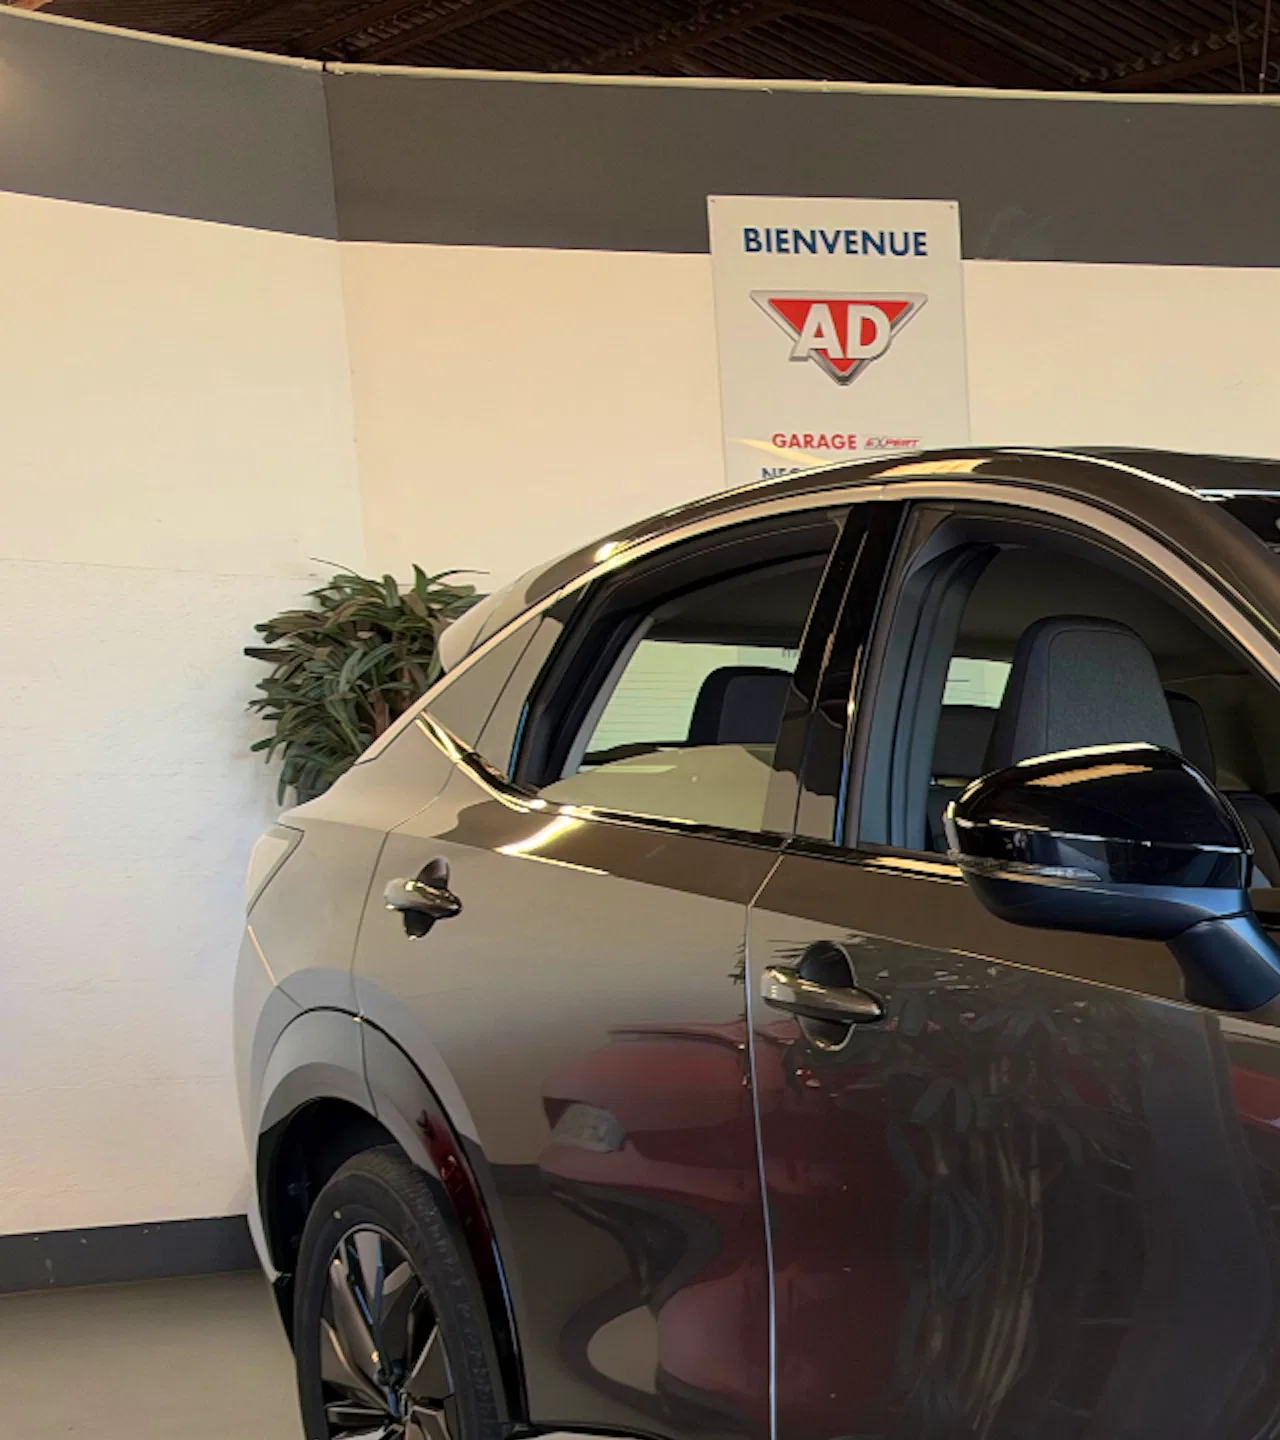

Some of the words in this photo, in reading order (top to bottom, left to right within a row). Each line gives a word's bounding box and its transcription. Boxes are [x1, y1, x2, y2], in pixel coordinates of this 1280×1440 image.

[743, 227, 929, 257] BIENVENUE
[788, 302, 892, 362] AD
[771, 432, 858, 451] GARAGE
